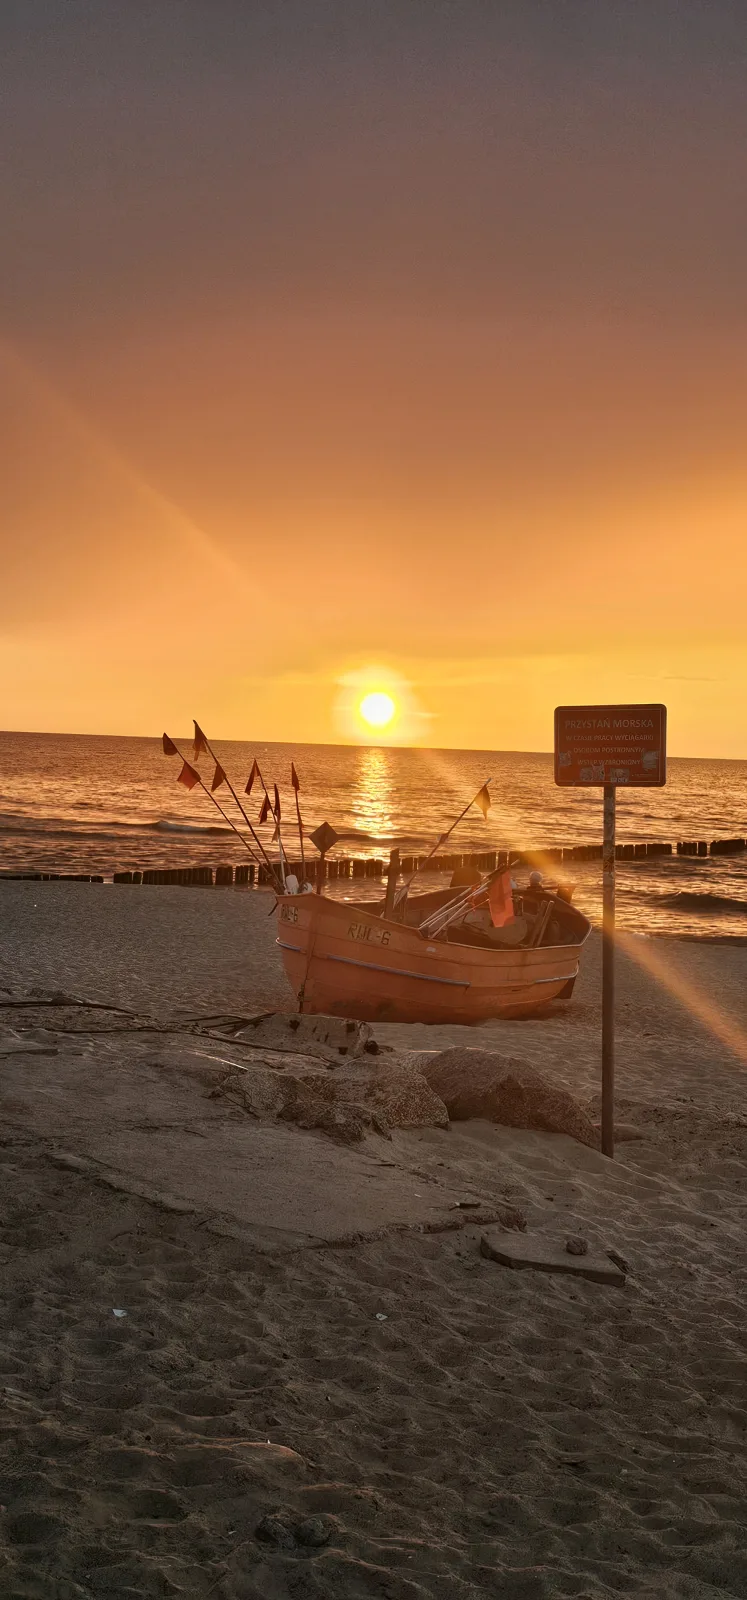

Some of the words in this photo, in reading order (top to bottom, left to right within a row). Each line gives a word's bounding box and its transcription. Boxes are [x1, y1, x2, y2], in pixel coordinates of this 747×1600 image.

[564, 717, 611, 729] PRZYSTAŃ
[613, 719, 654, 728] MORSKA
[614, 734, 654, 742] WYCIĄGARKI
